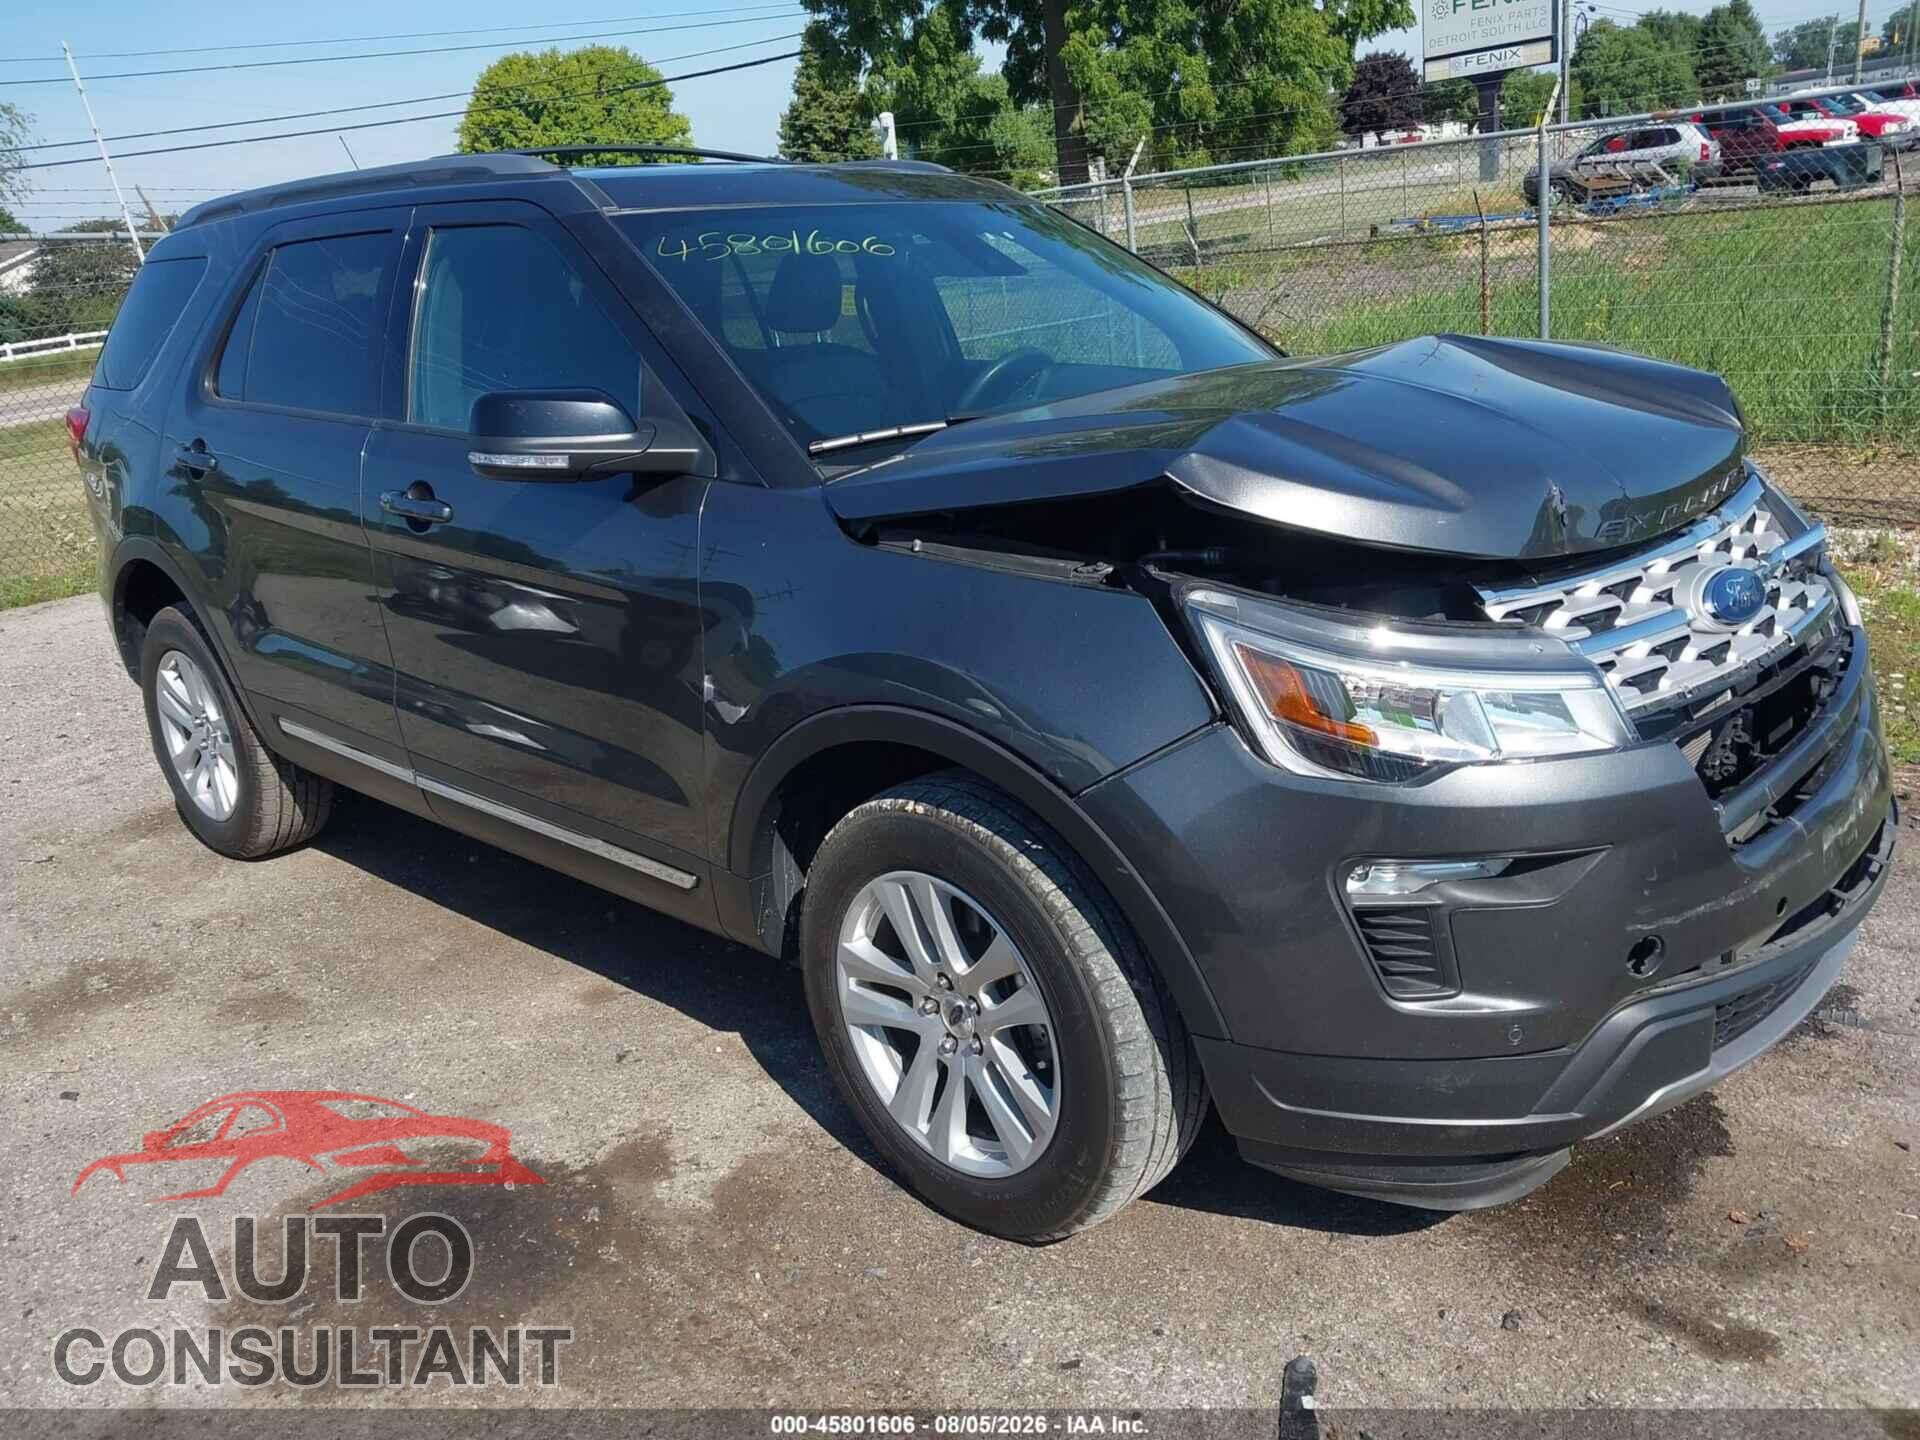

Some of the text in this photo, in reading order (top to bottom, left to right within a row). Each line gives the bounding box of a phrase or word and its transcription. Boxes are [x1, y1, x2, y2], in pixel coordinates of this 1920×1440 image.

[1470, 13, 1504, 28] FENIX
[1509, 7, 1546, 21] PARTS
[1428, 18, 1547, 49] DETROIT SOUTH LLC
[1464, 47, 1521, 67] FENIX
[657, 230, 896, 261] 45801606
